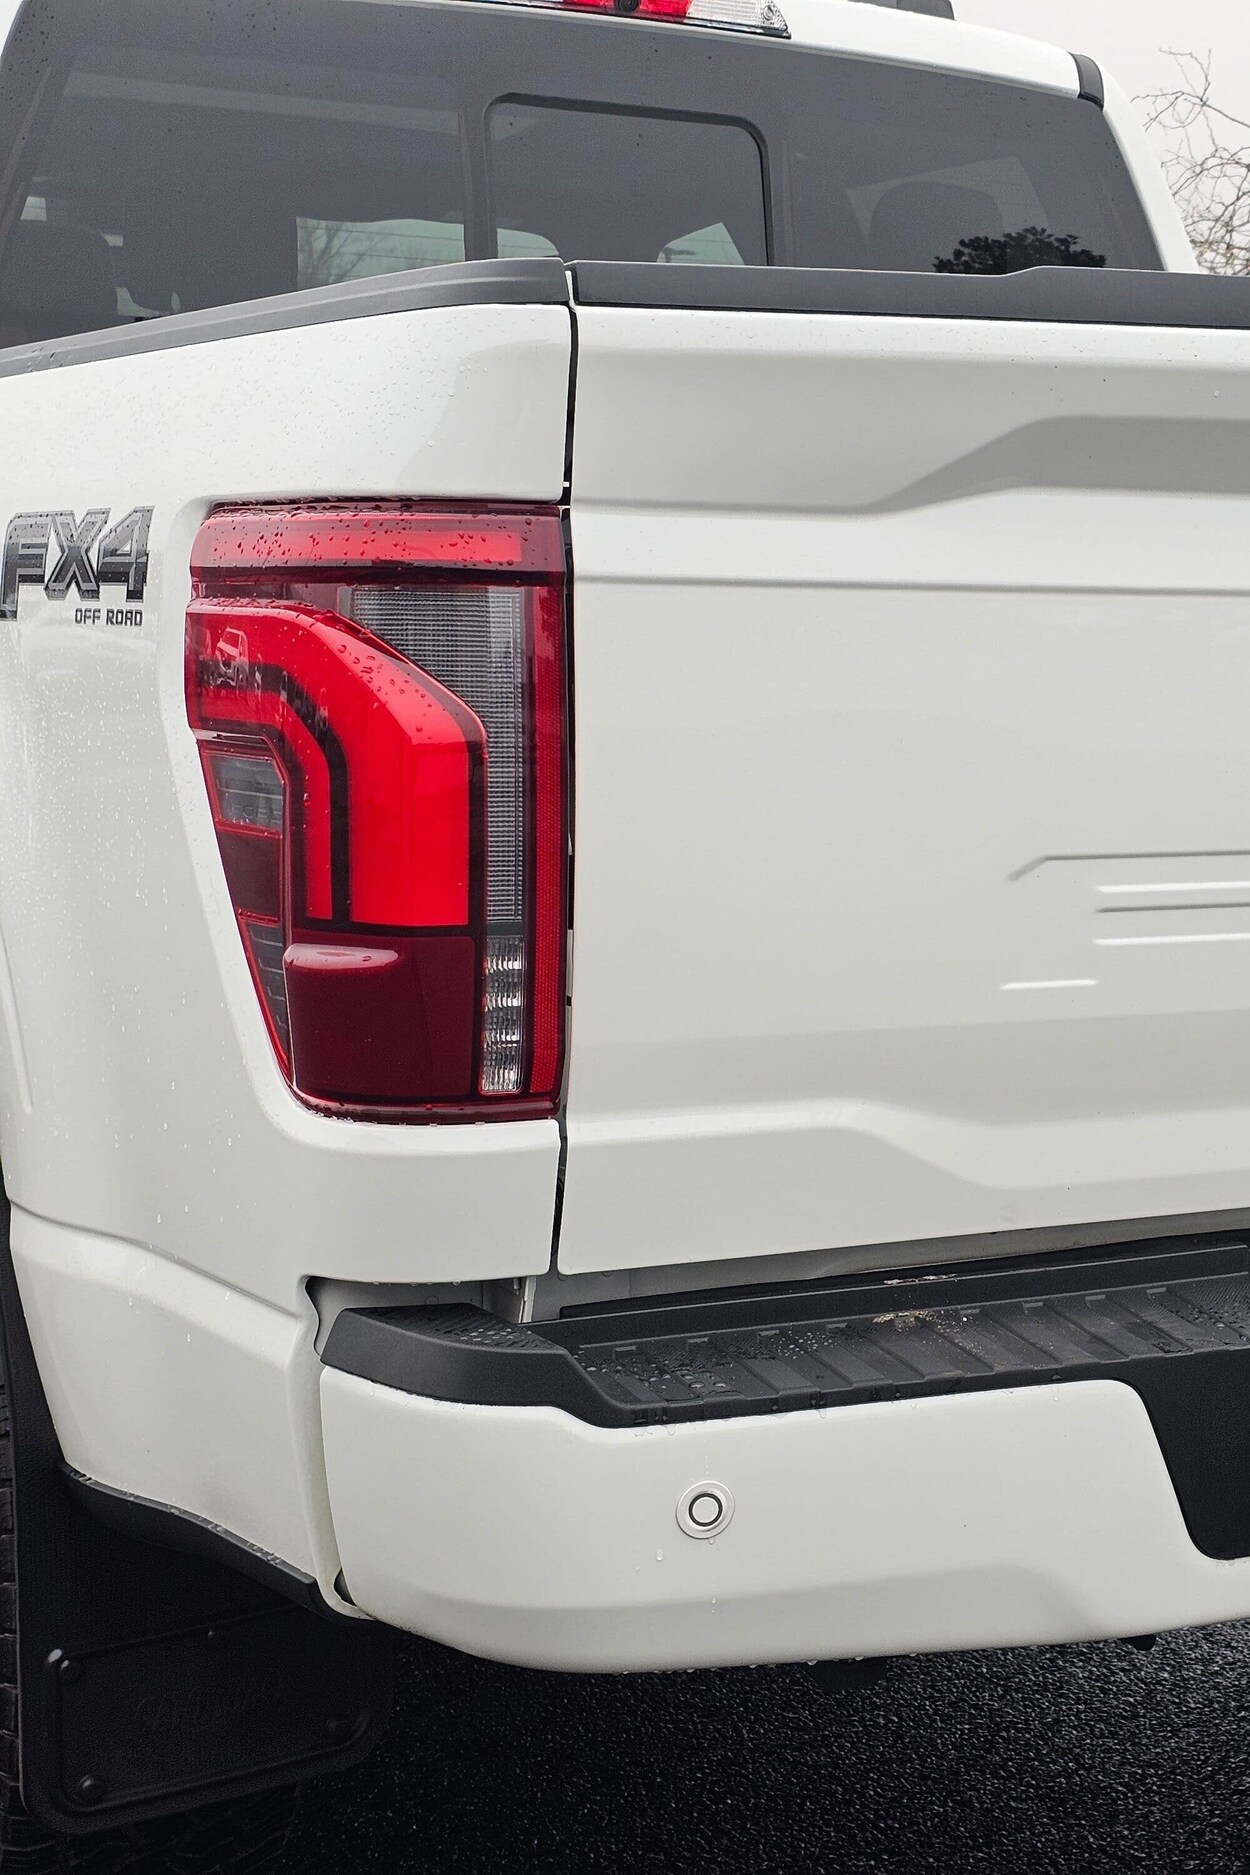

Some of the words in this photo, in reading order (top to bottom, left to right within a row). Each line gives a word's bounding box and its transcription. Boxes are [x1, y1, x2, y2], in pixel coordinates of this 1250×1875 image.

[0, 506, 155, 621] FX4
[74, 608, 101, 625] OFF
[105, 609, 143, 626] ROAD
